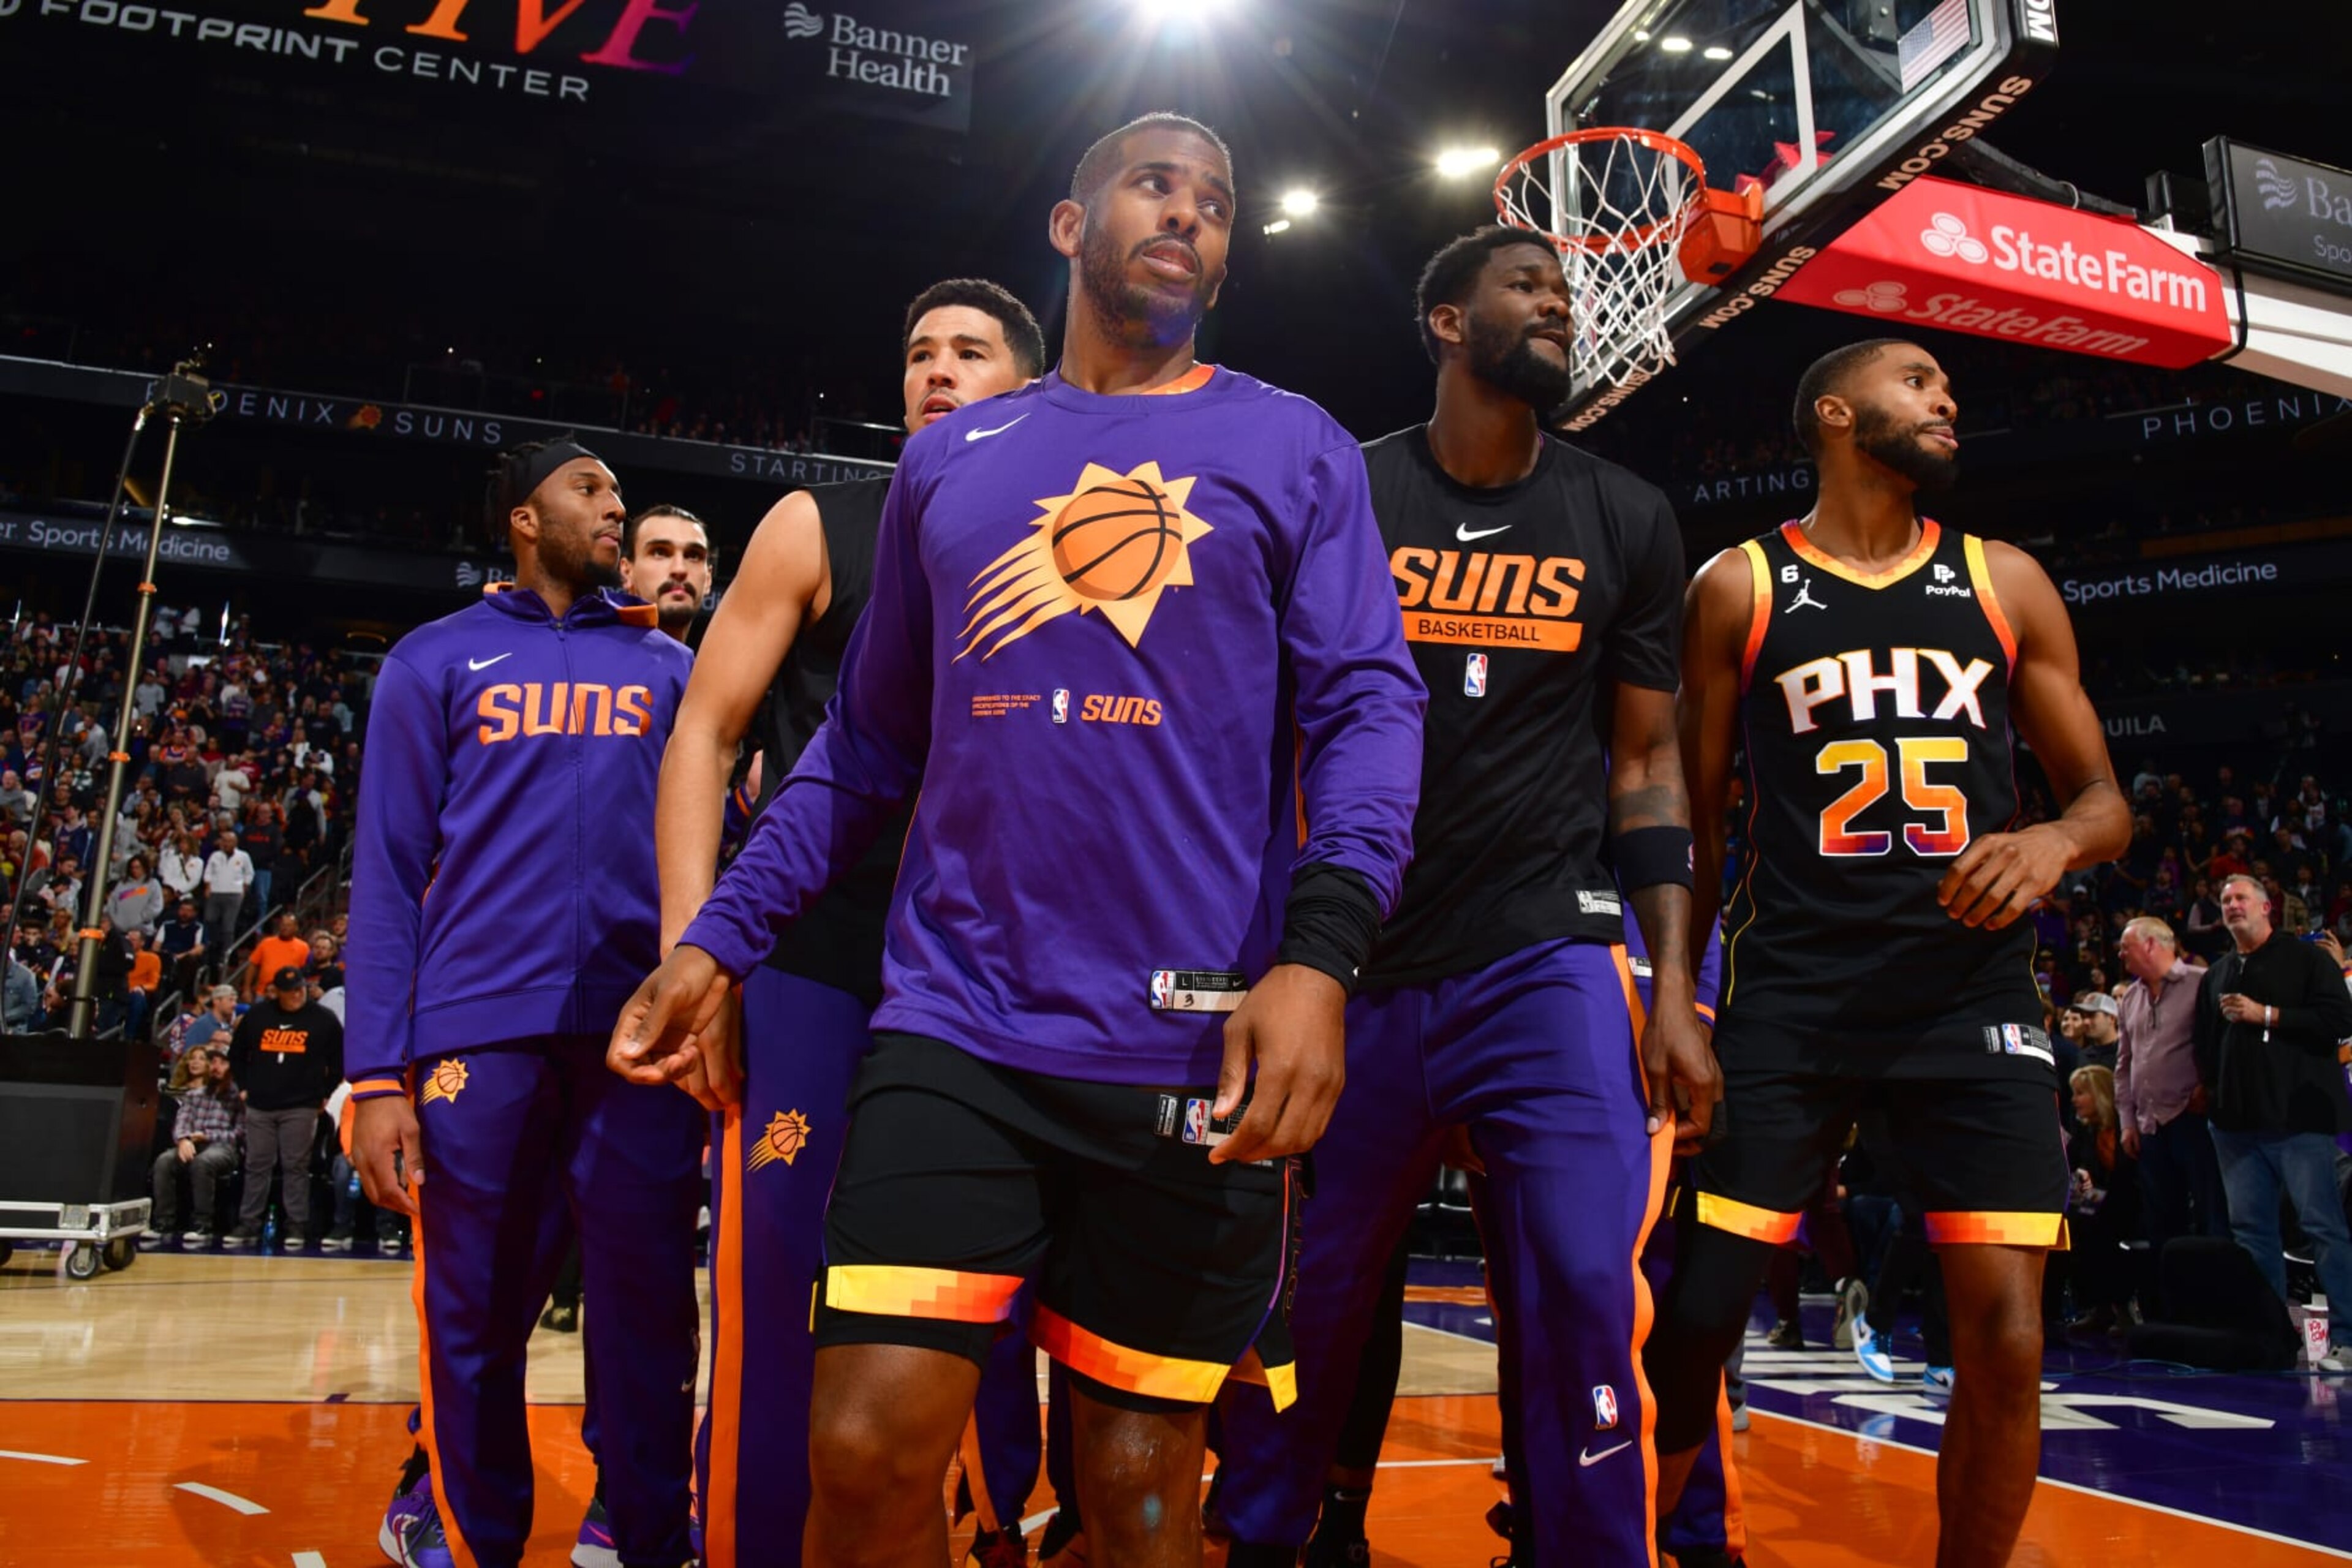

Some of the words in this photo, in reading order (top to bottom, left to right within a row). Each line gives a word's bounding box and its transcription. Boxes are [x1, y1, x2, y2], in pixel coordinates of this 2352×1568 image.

[41, 0, 359, 62] FOOTPRINT
[374, 47, 589, 101] CENTER
[830, 13, 968, 66] Banner
[827, 47, 952, 97] Health
[1876, 75, 2033, 191] SUNS.COM
[1698, 246, 1817, 329] SUNS.COM
[146, 382, 334, 424] OENIX
[395, 412, 503, 445] SUNS
[28, 520, 114, 548] Sports
[119, 531, 230, 562] Mdicine
[1390, 546, 1587, 618] SUNS
[1781, 564, 1799, 583] 6
[1925, 584, 1972, 598] PayPal
[2063, 575, 2152, 605] Sports
[2157, 562, 2278, 591] Medicine
[1418, 618, 1541, 642] BASKETBALL
[477, 682, 654, 746] SUNS
[1080, 695, 1163, 726] SUNS
[1773, 647, 1994, 735] PHX
[1815, 737, 1970, 858] 25
[1183, 993, 1194, 1008] 3
[262, 1028, 309, 1045] SUNS
